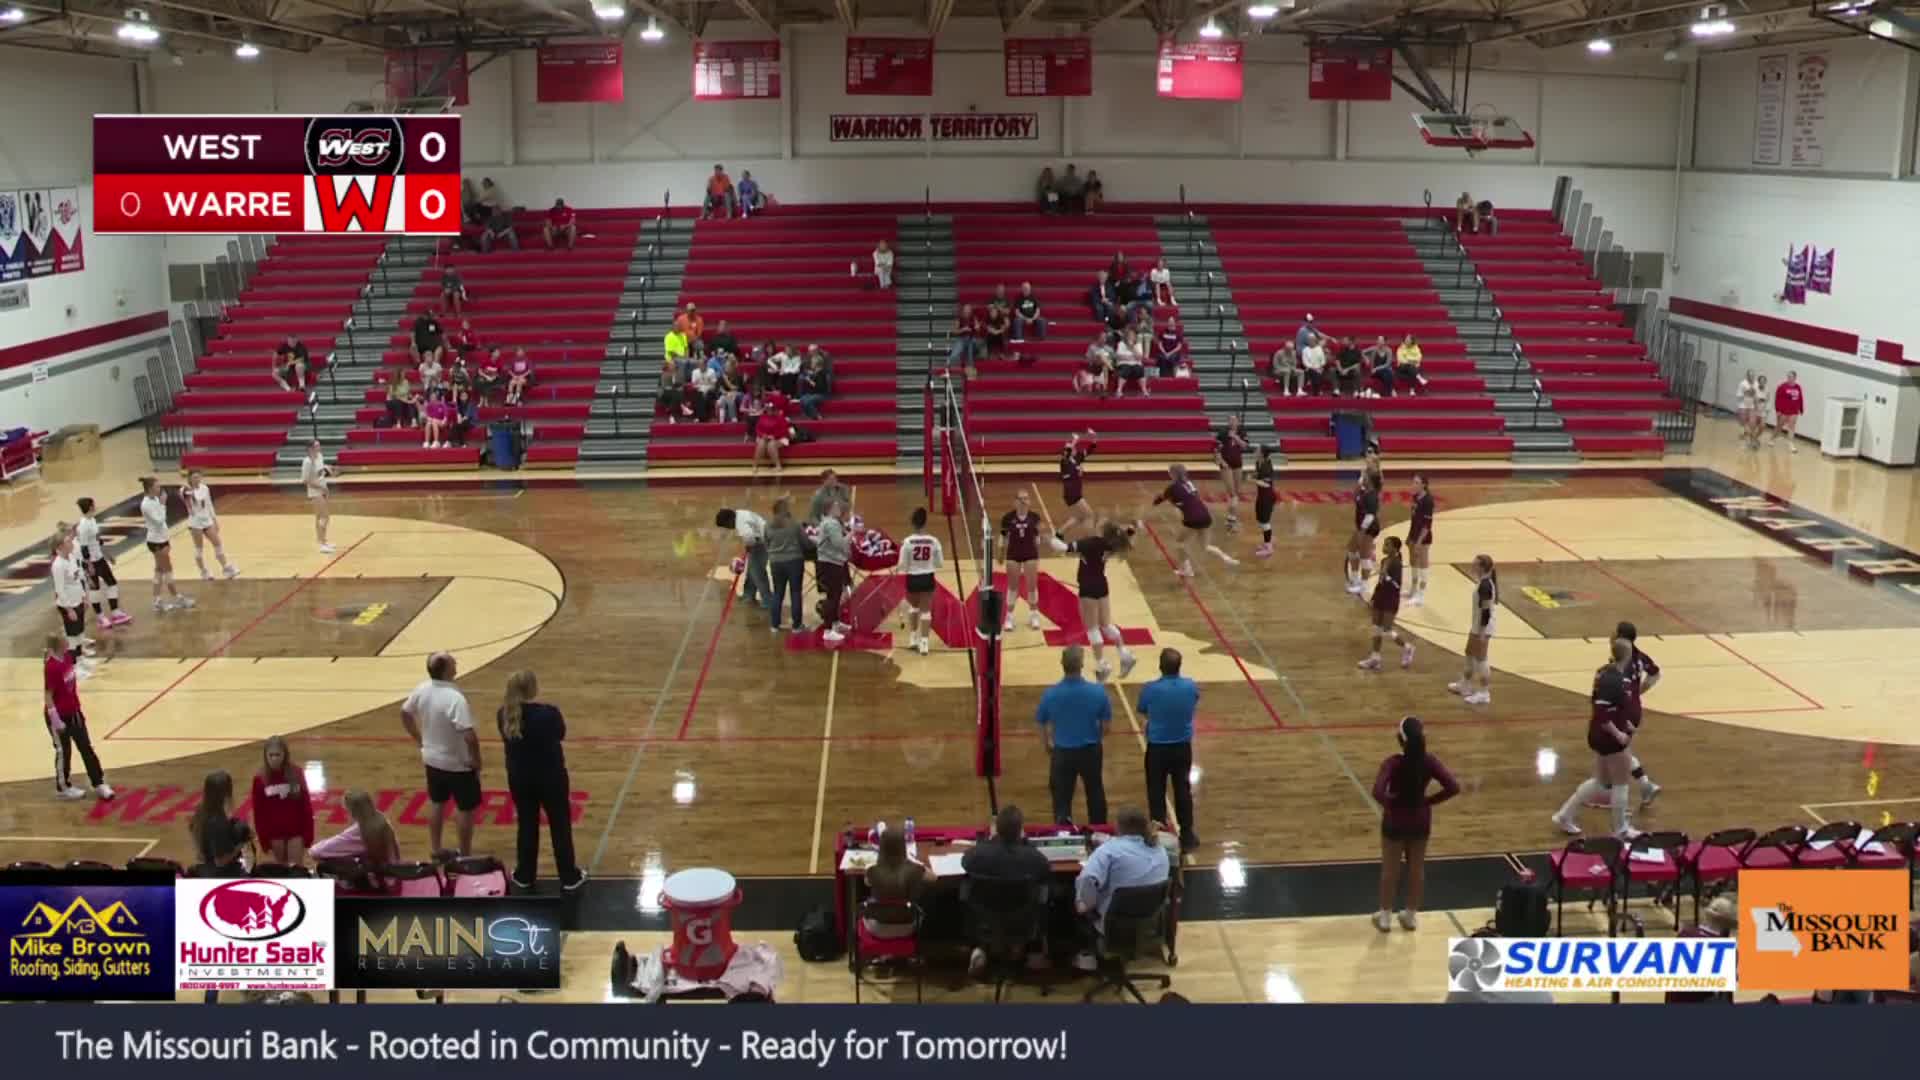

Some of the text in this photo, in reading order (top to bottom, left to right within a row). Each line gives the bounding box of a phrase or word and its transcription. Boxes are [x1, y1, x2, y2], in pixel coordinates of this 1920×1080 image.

[833, 117, 1033, 139] WARRIOR TERRITORY
[686, 918, 713, 945] G
